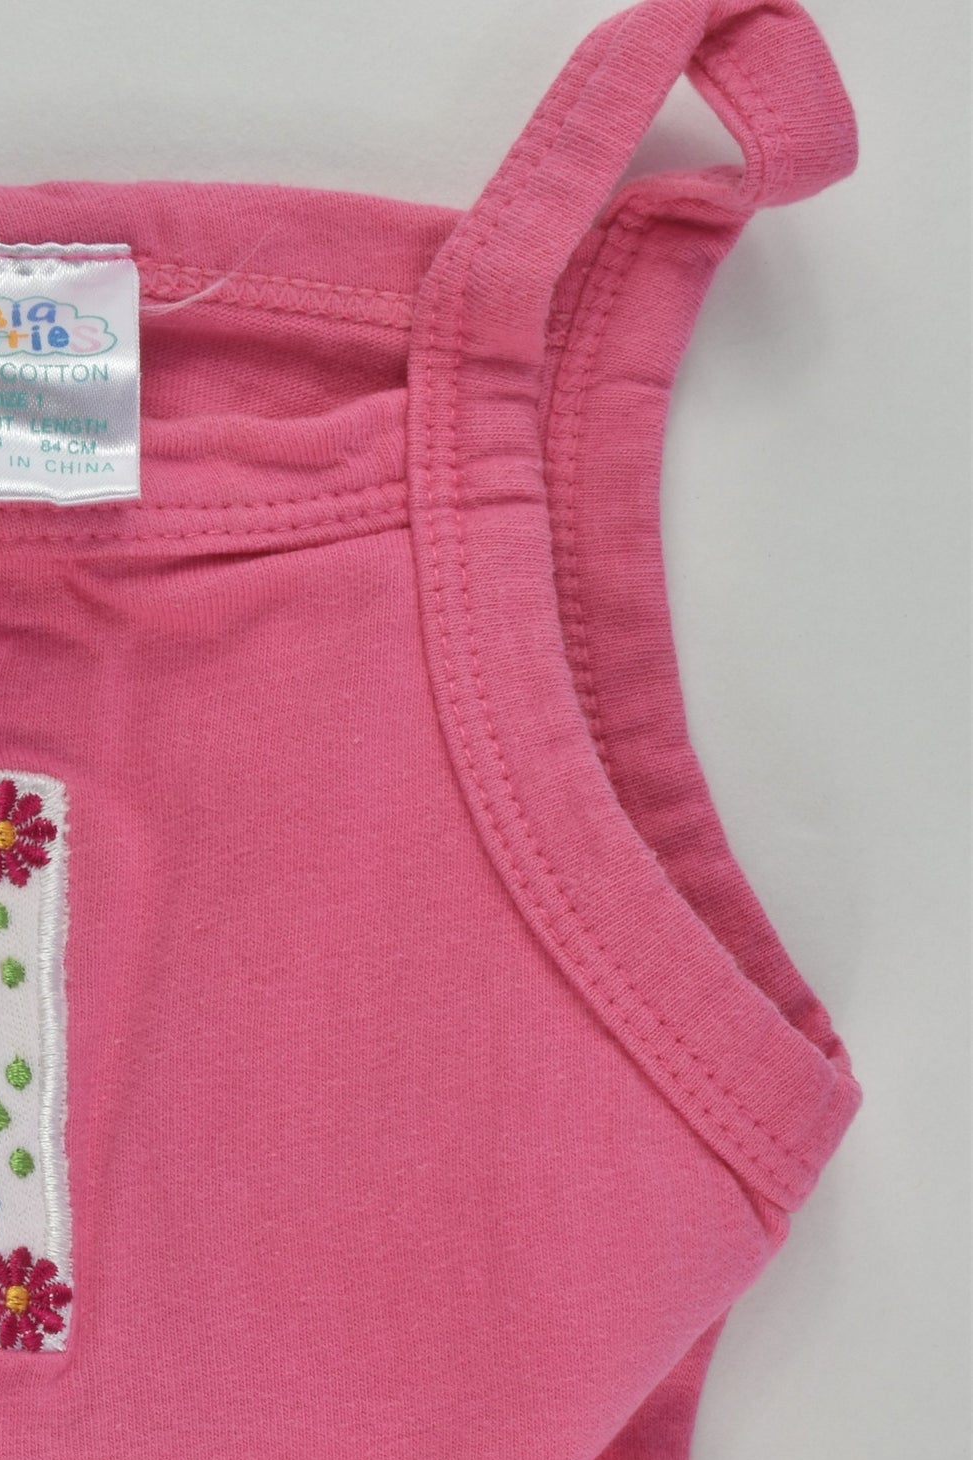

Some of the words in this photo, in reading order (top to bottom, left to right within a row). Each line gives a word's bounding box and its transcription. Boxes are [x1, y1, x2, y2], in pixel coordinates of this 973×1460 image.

[0, 363, 109, 383] COTTON
[36, 393, 43, 409] 1
[31, 416, 107, 434] LENGTH
[41, 440, 61, 452] 84
[68, 440, 97, 454] CM
[9, 455, 31, 468] IN
[45, 459, 115, 474] CHINA
